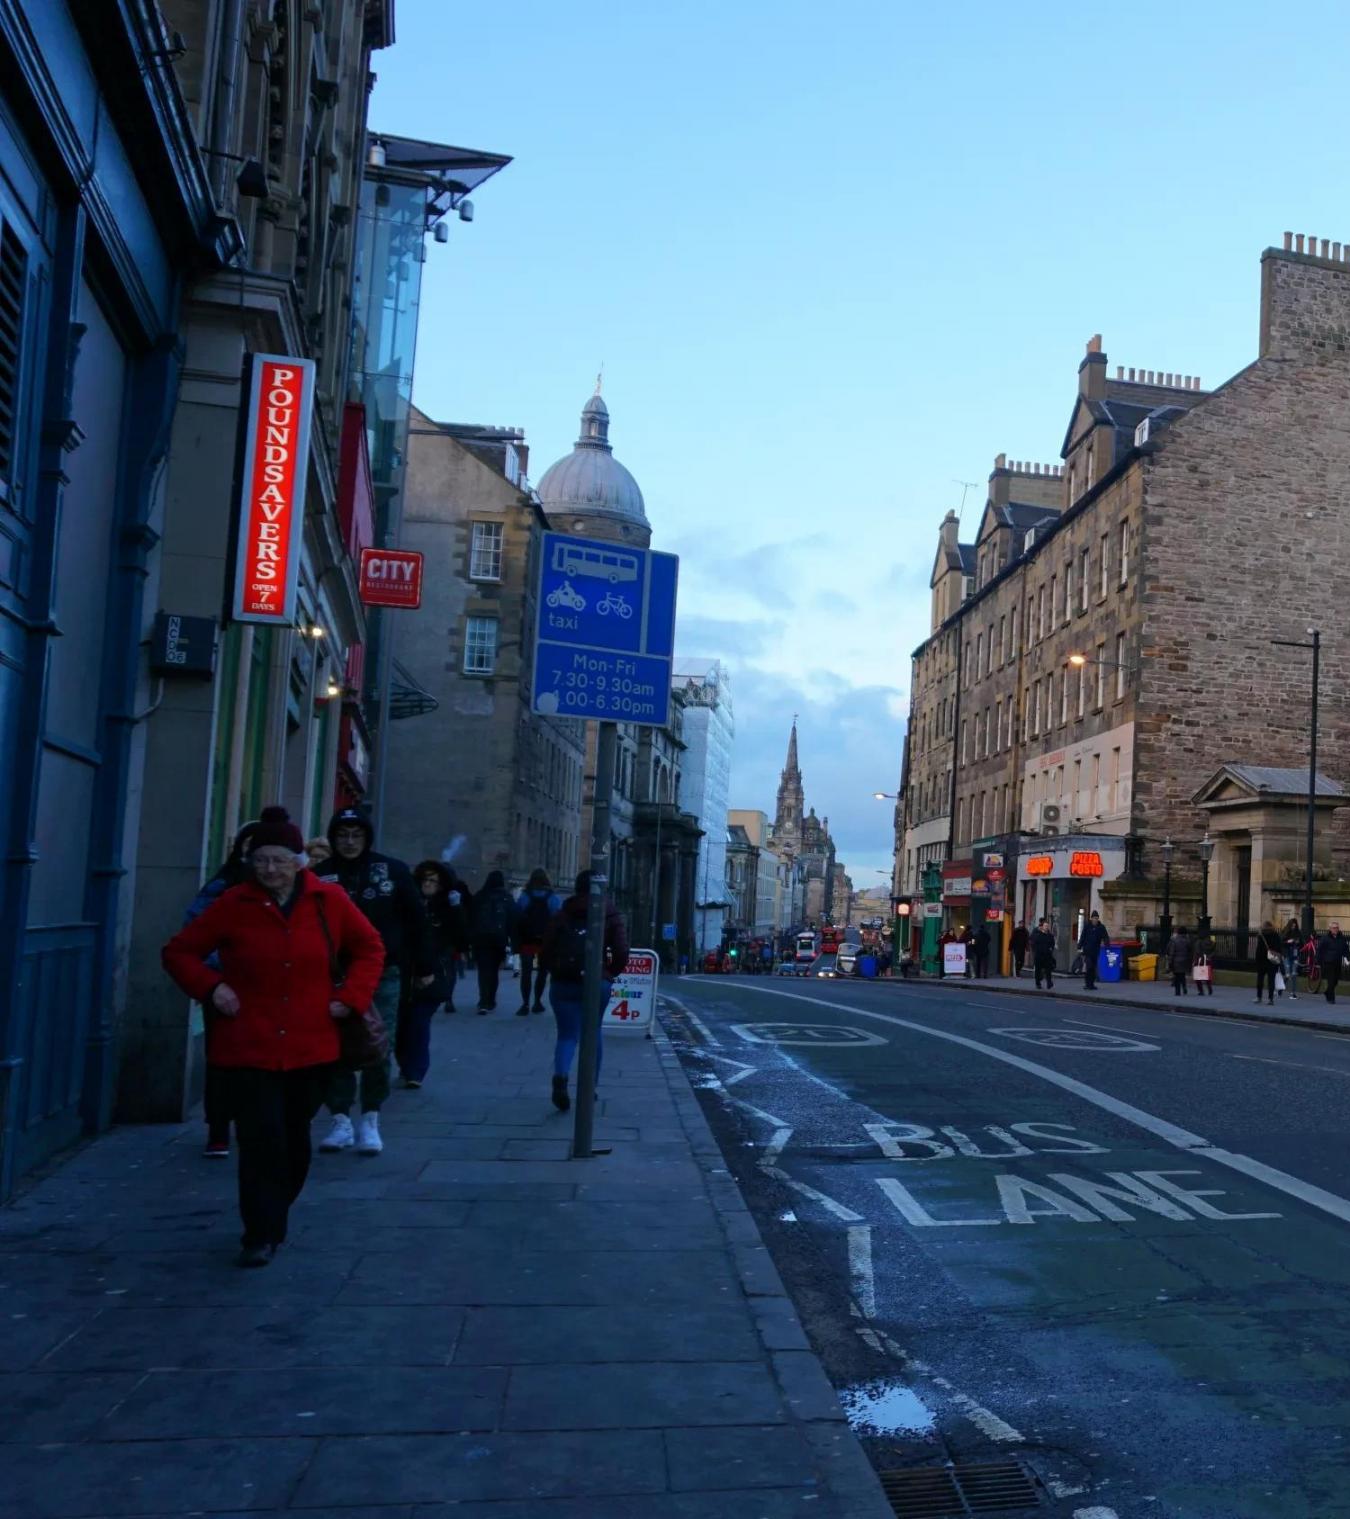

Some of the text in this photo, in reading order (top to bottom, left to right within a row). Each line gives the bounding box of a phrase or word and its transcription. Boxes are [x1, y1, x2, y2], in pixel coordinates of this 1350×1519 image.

[255, 368, 295, 580] POUNDSAVERS
[367, 558, 416, 582] CITY
[251, 583, 278, 592] OPEN
[260, 592, 268, 602] 7
[251, 602, 276, 612] DAYS
[549, 613, 579, 630] taxi
[573, 654, 636, 675] Mon-Fri
[552, 671, 654, 696] 7.30-9.30am
[1073, 852, 1100, 864] PIZZA
[1070, 863, 1103, 876] POSTO
[862, 1121, 1112, 1162] BUS
[874, 1169, 1284, 1227] LANE
